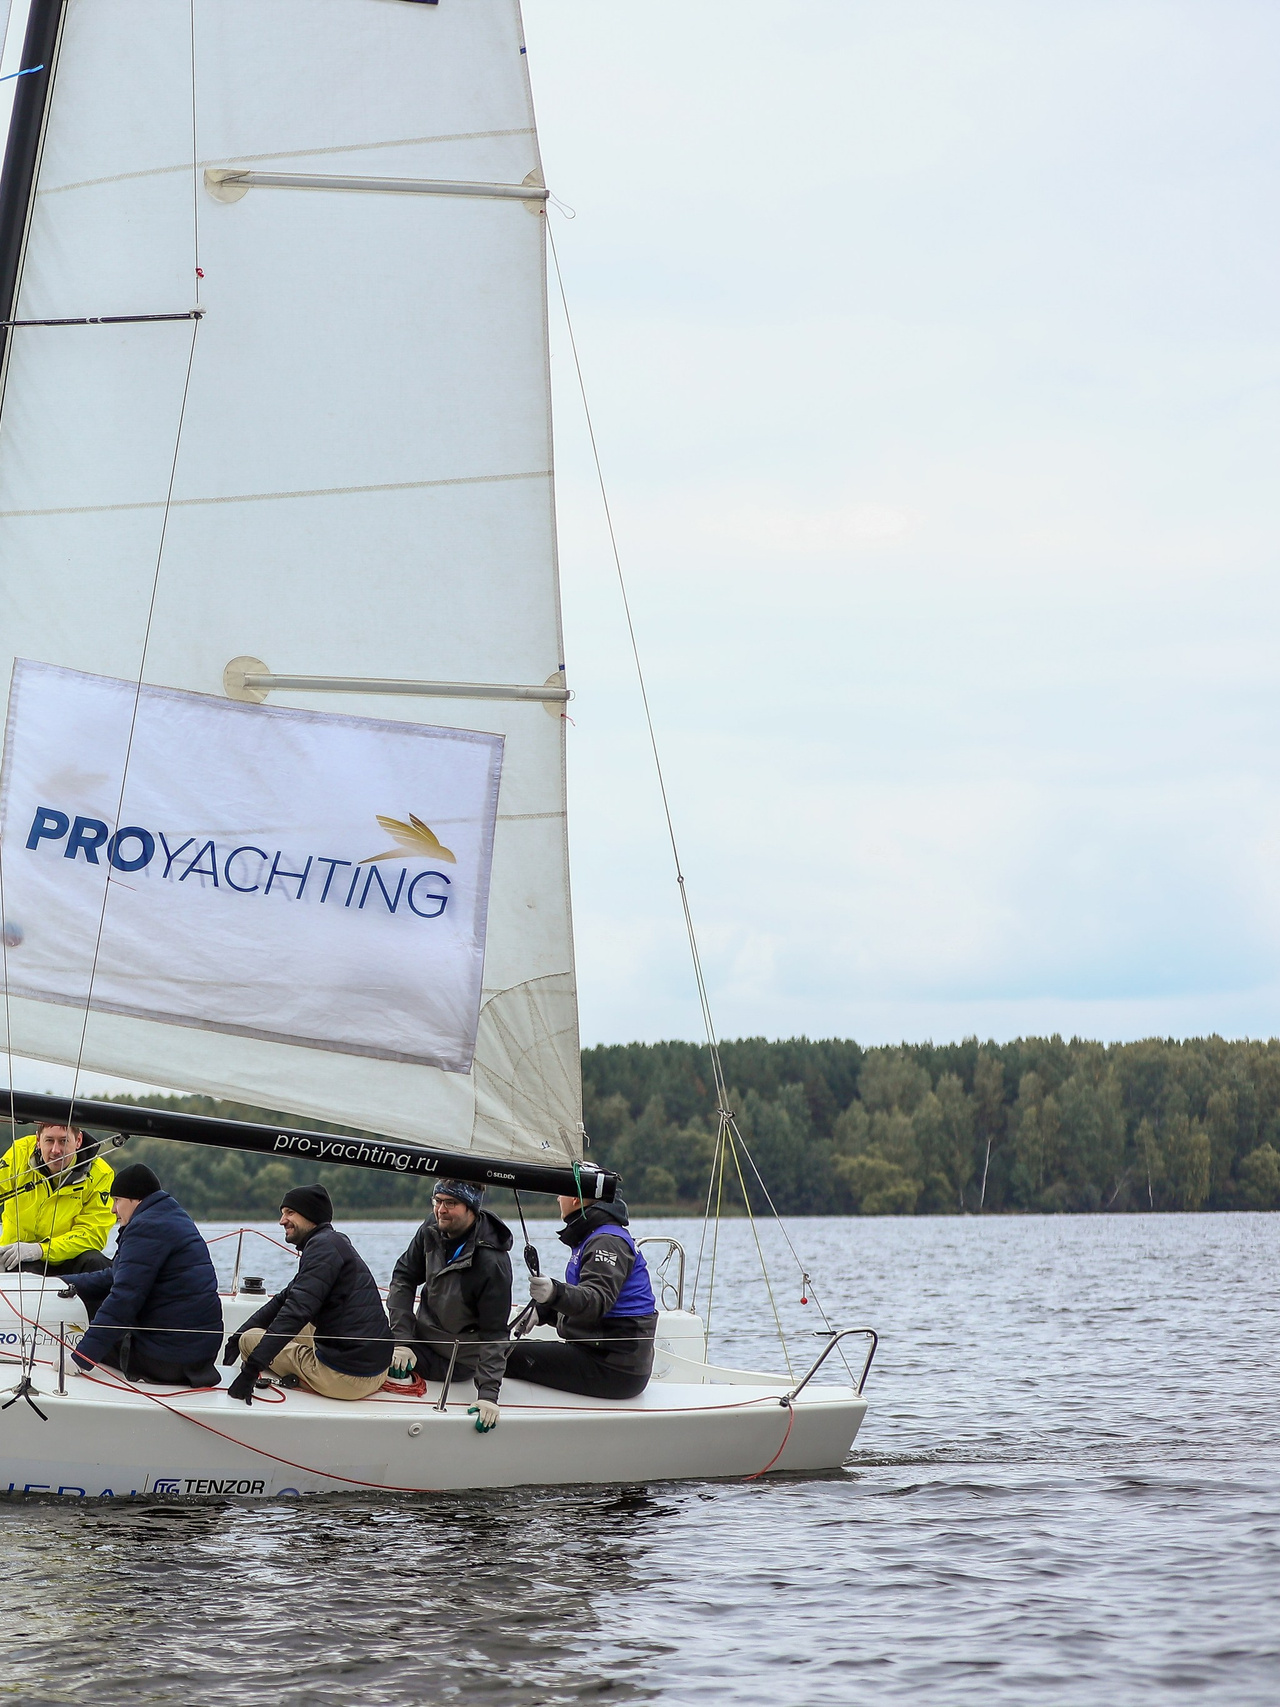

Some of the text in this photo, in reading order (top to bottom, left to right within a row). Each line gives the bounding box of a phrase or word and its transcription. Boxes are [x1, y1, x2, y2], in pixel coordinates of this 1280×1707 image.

[26, 805, 452, 919] PROYACHTING
[274, 1134, 439, 1171] pro-yachting.ru
[185, 1479, 266, 1494] TENZOR
